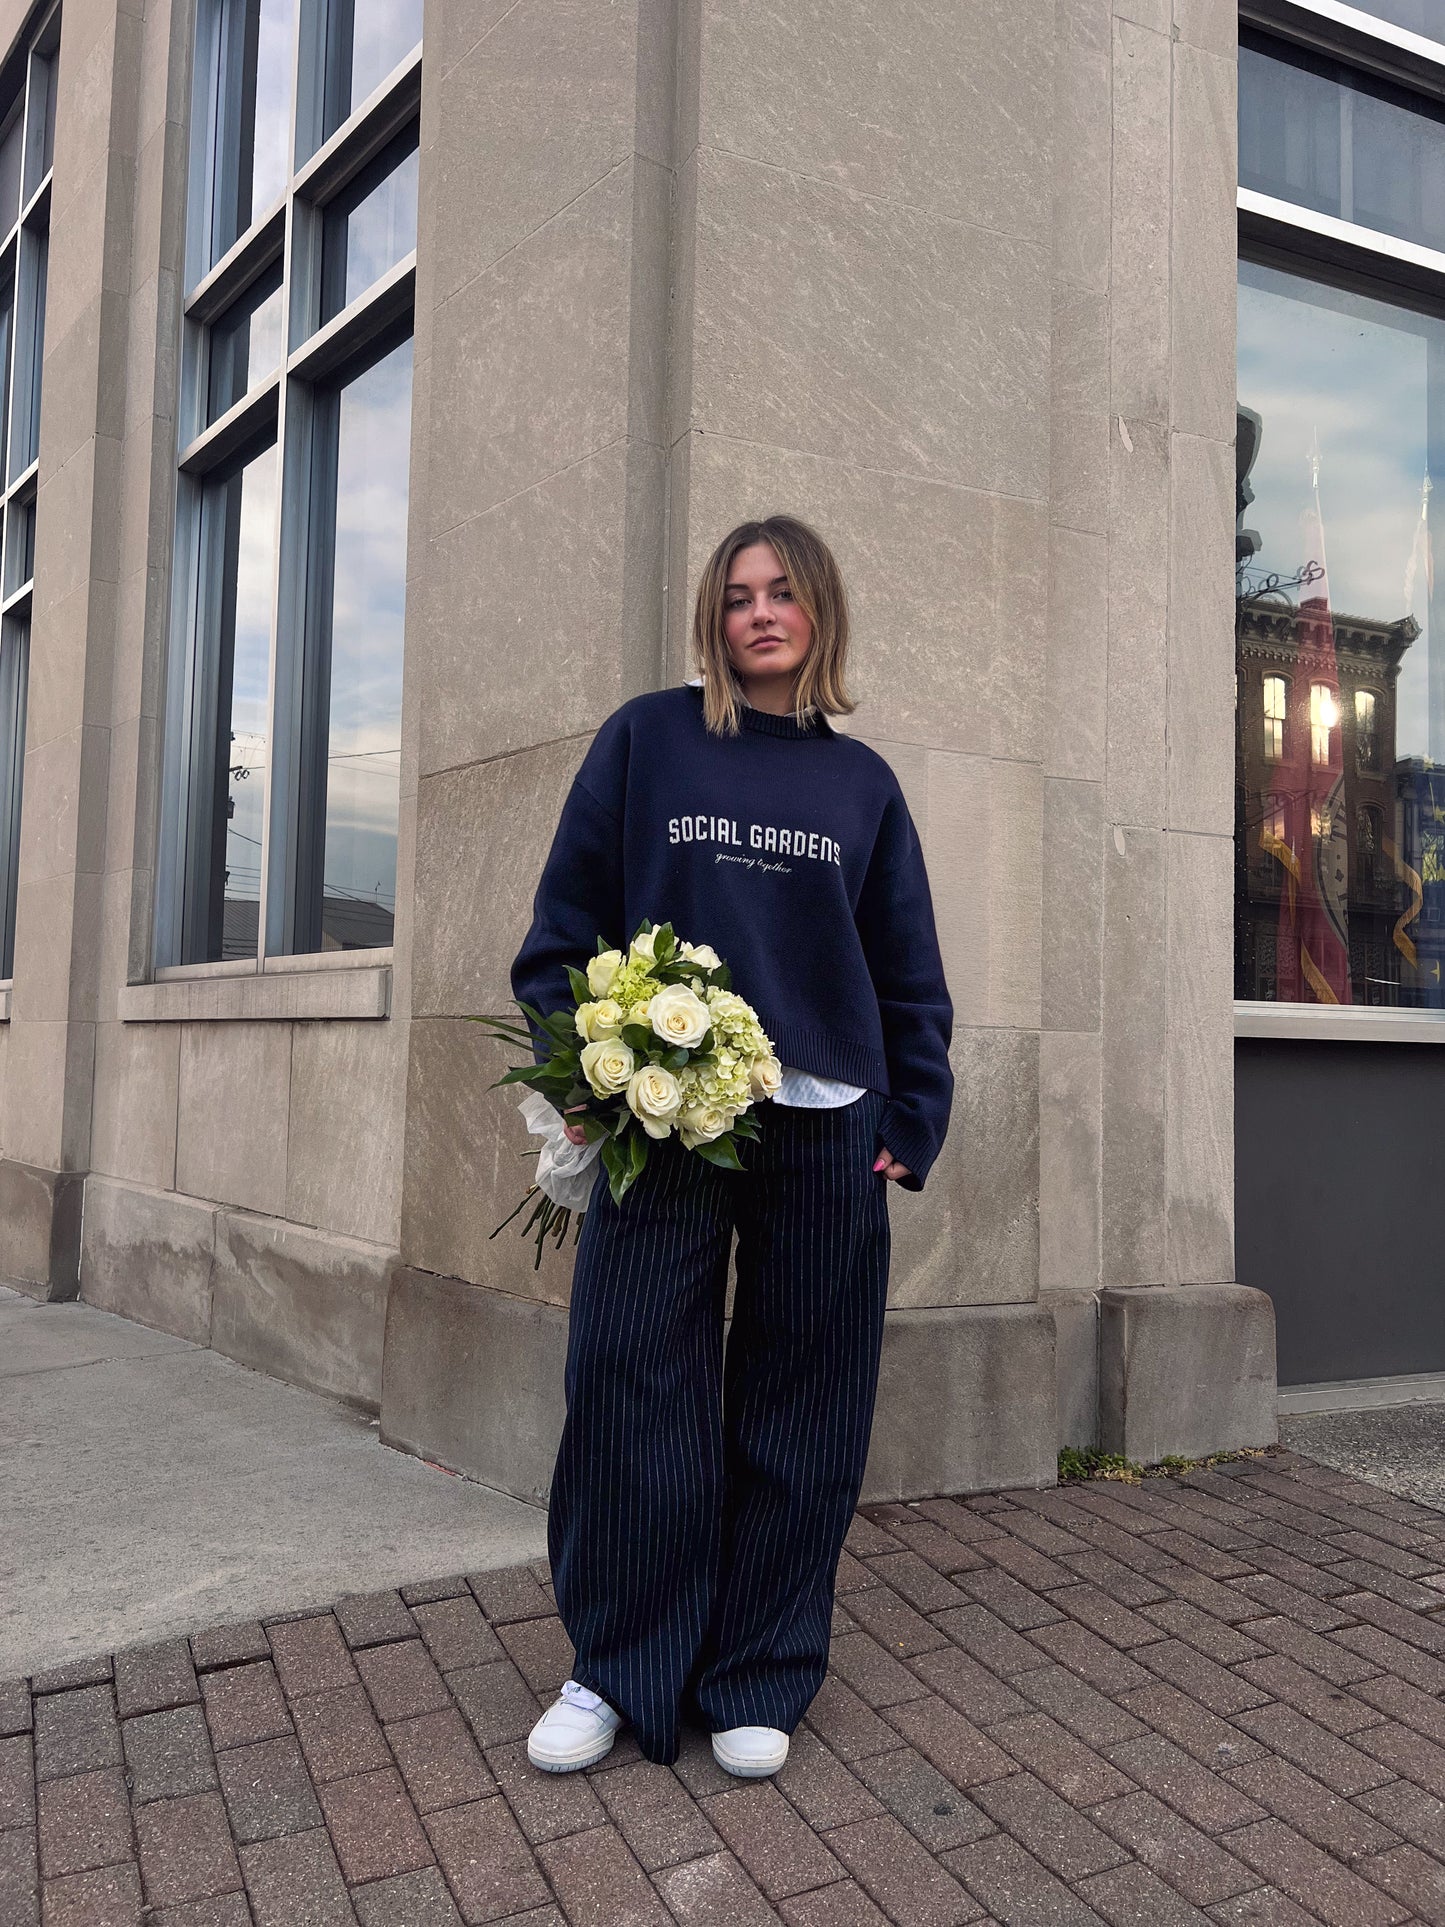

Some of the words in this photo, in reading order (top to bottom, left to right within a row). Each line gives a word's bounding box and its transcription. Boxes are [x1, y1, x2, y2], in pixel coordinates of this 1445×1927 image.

[668, 815, 742, 846] SOCIAL
[750, 824, 841, 866] GARDENS
[714, 853, 756, 869] growing
[757, 858, 792, 873] together
